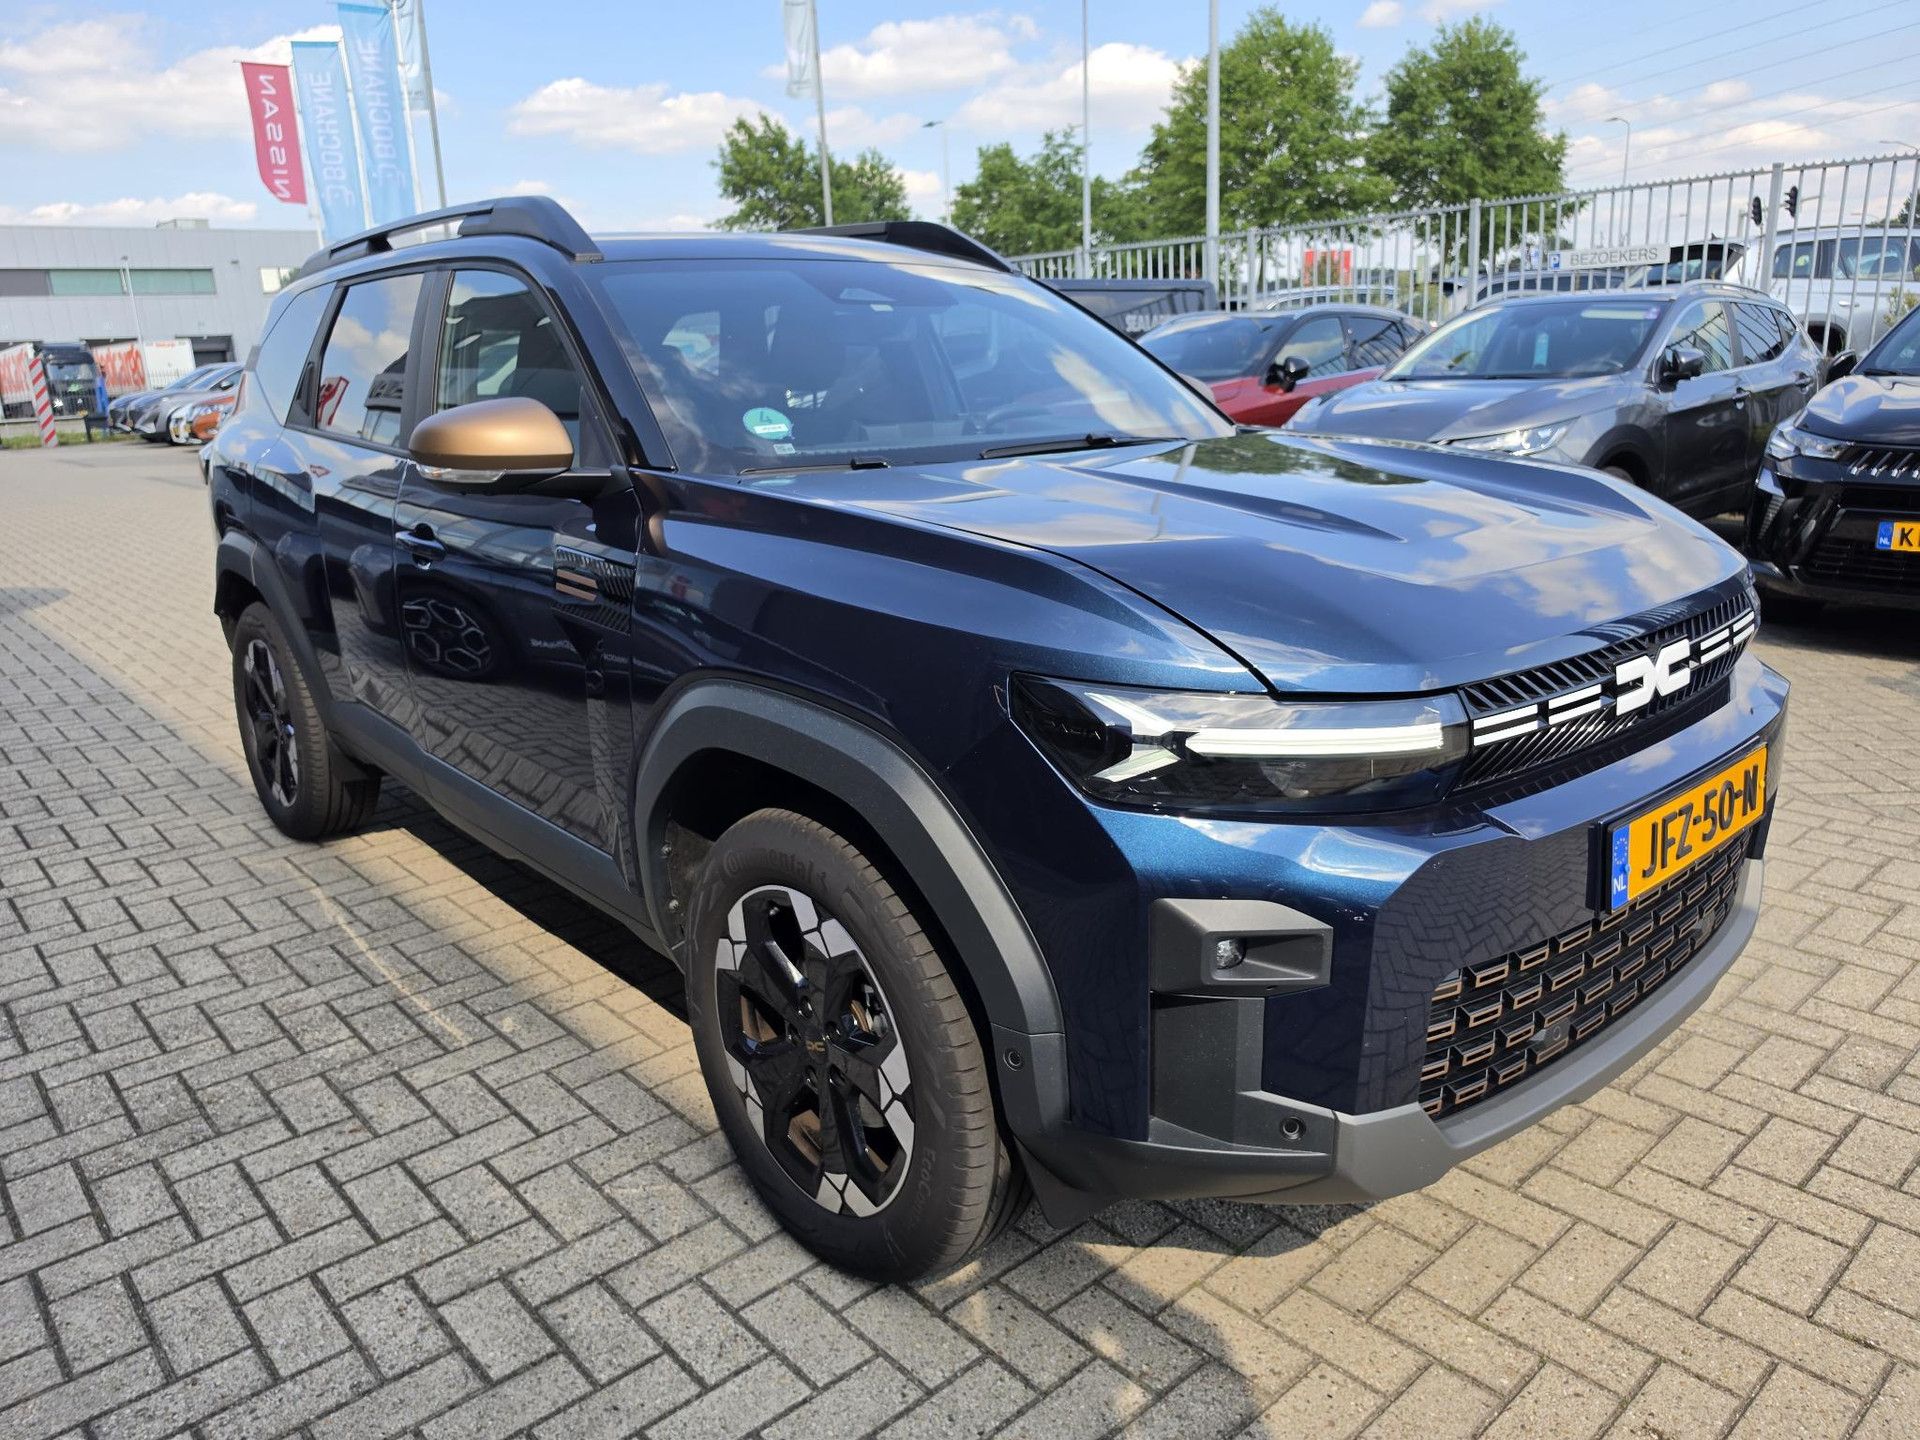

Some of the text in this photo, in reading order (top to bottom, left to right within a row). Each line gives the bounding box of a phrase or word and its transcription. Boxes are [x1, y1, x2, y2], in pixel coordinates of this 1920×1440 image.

[1570, 247, 1658, 267] BEZOEKERS
[1899, 527, 1920, 547] K
[1613, 764, 1759, 895] NL JFZ-50-N
